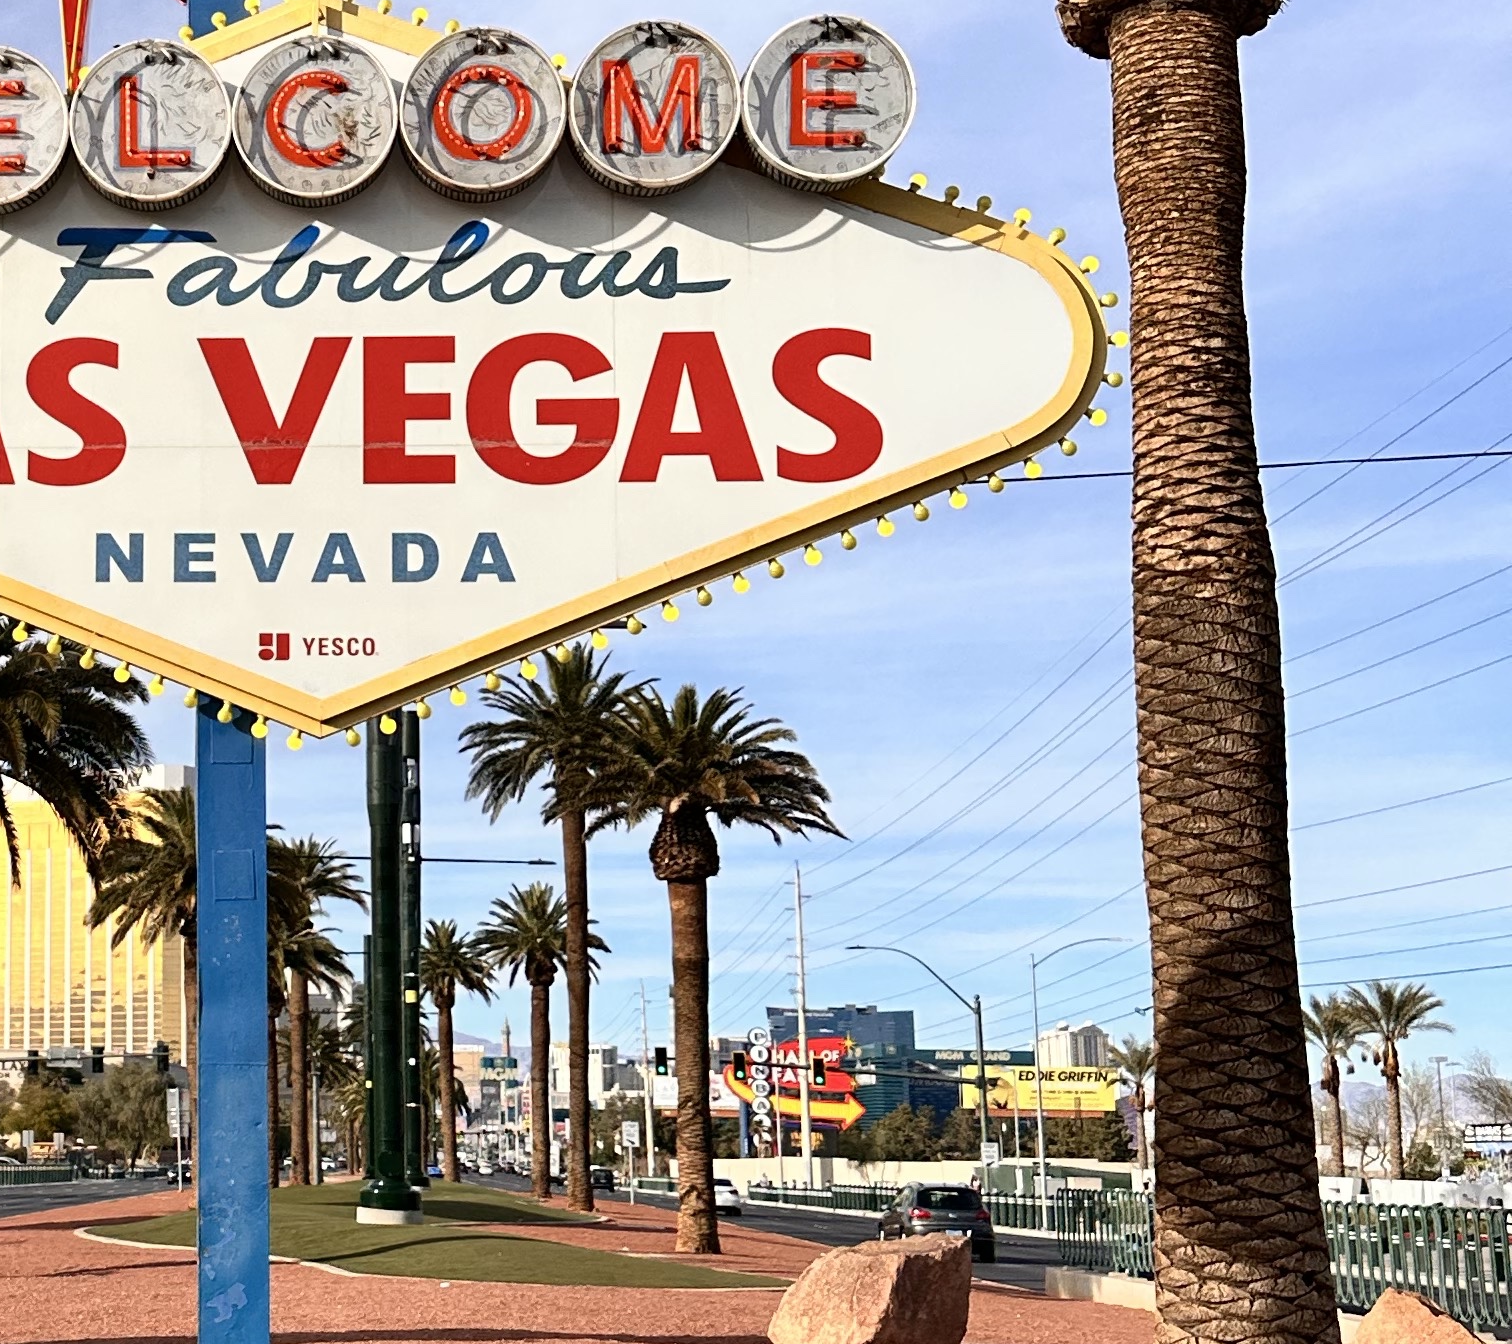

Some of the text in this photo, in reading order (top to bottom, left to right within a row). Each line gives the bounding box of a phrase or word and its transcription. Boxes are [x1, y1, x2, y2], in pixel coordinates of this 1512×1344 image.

[44, 219, 731, 326] Fabulous
[197, 327, 885, 487] VEGAS
[94, 532, 517, 583] NEVADA
[302, 637, 376, 657] YESCO
[821, 1050, 840, 1062] OF
[935, 1050, 965, 1060] MGM
[479, 1067, 518, 1081] MGM
[1057, 1070, 1108, 1082] GRIFFIN
[748, 1028, 773, 1147] PINBA
